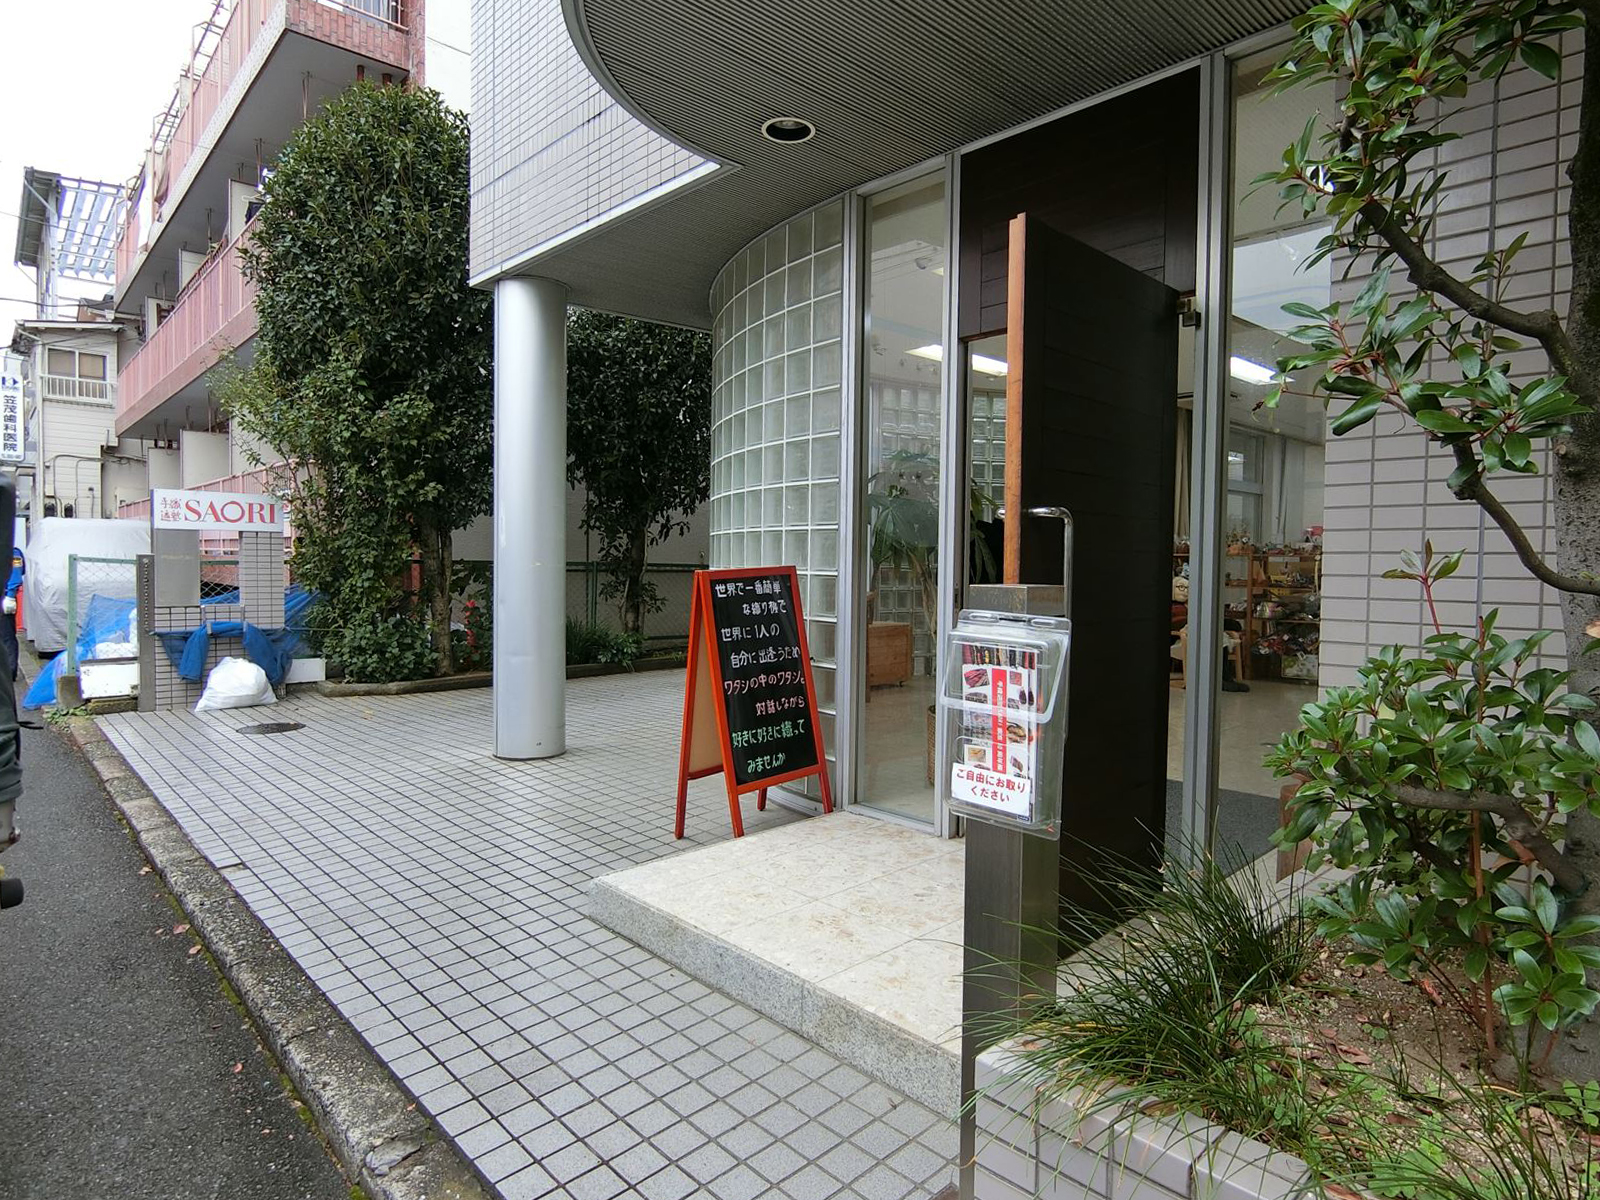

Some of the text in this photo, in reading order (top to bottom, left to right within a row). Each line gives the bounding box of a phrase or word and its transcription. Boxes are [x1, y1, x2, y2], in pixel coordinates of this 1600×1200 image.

[184, 499, 279, 524] SAORI
[715, 580, 782, 598] 世界で一番簡単
[742, 599, 787, 615] な織り機で
[721, 623, 780, 641] 世界に1人の
[731, 646, 801, 668] 自分に出逢うため
[724, 670, 806, 695] ワタシの中のワタシと
[755, 695, 805, 716] 対話しながら
[732, 719, 805, 748] 好きに好きに織って
[747, 752, 786, 773] みませんか
[956, 769, 1026, 793] ご自由にお取り
[971, 786, 1010, 802] ください
